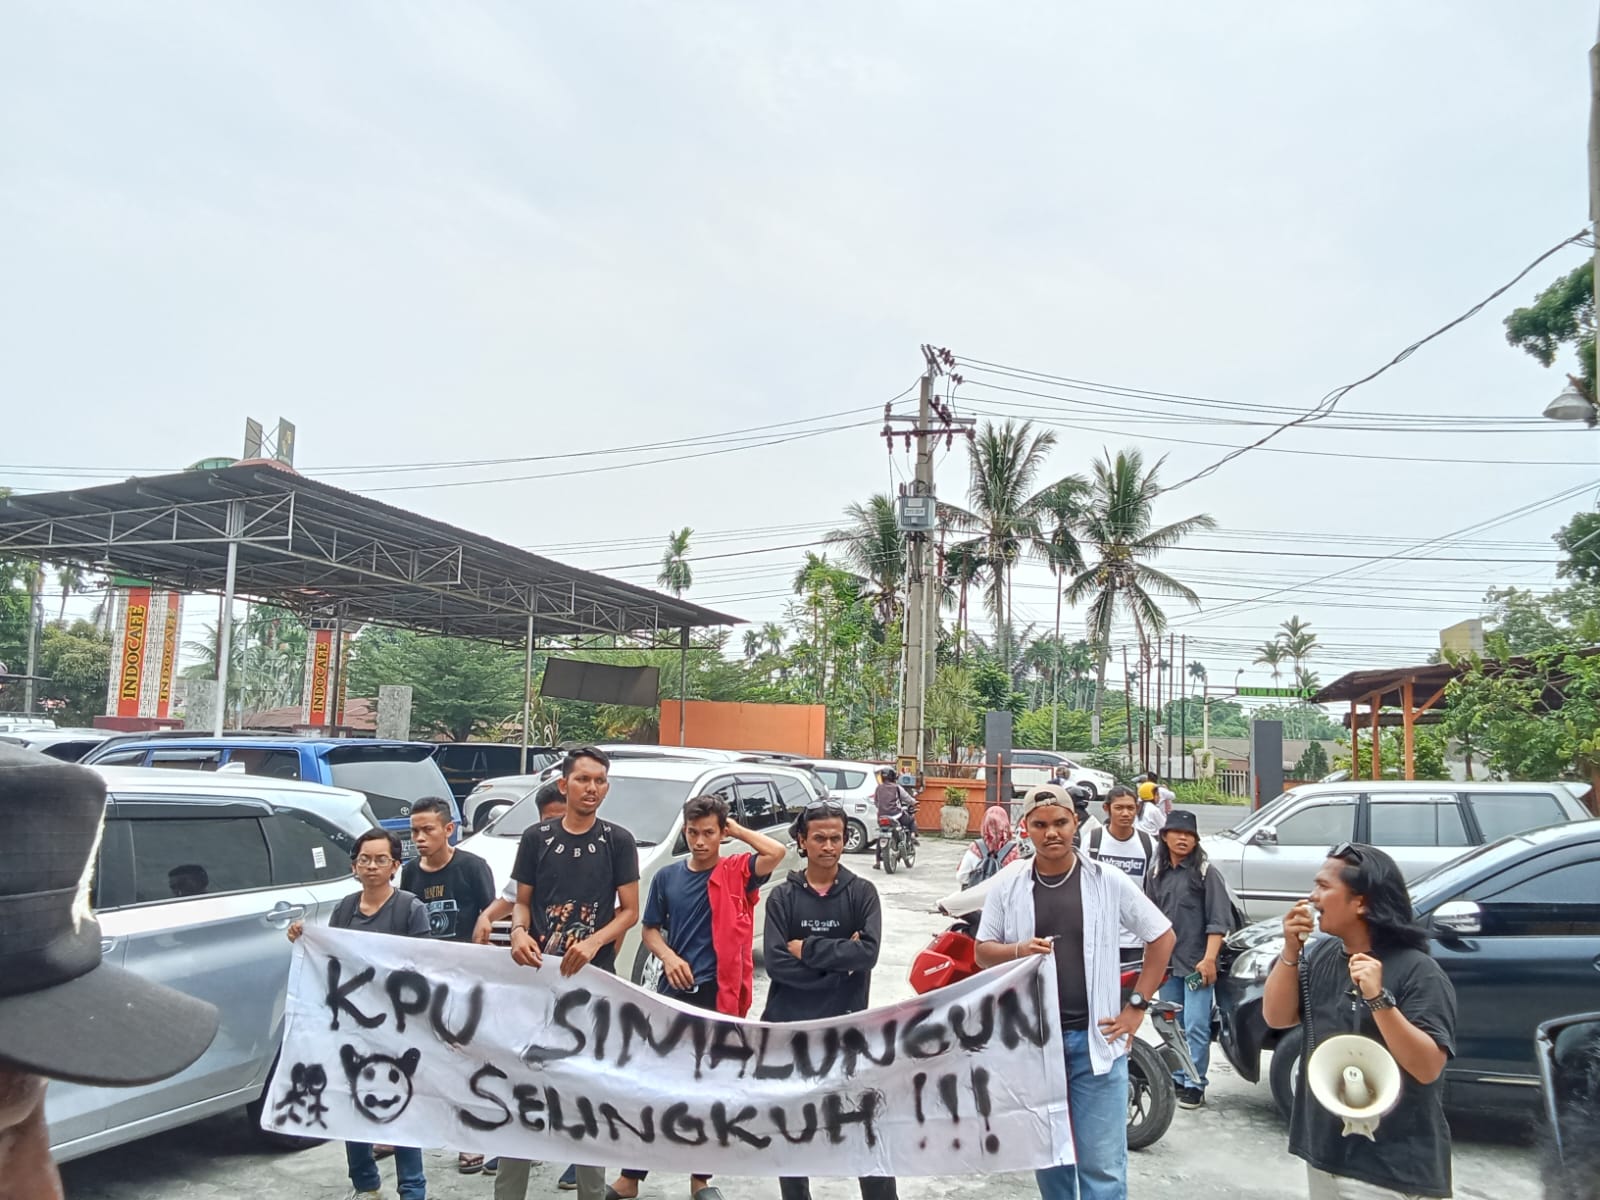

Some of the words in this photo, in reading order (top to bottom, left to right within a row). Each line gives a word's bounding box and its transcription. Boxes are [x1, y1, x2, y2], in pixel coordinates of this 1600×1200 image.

[1102, 856, 1143, 873] Wrangler
[326, 956, 484, 1048] KPU
[522, 973, 1050, 1080] SIMALUNGUN
[458, 1064, 880, 1148] SELINGKUH
